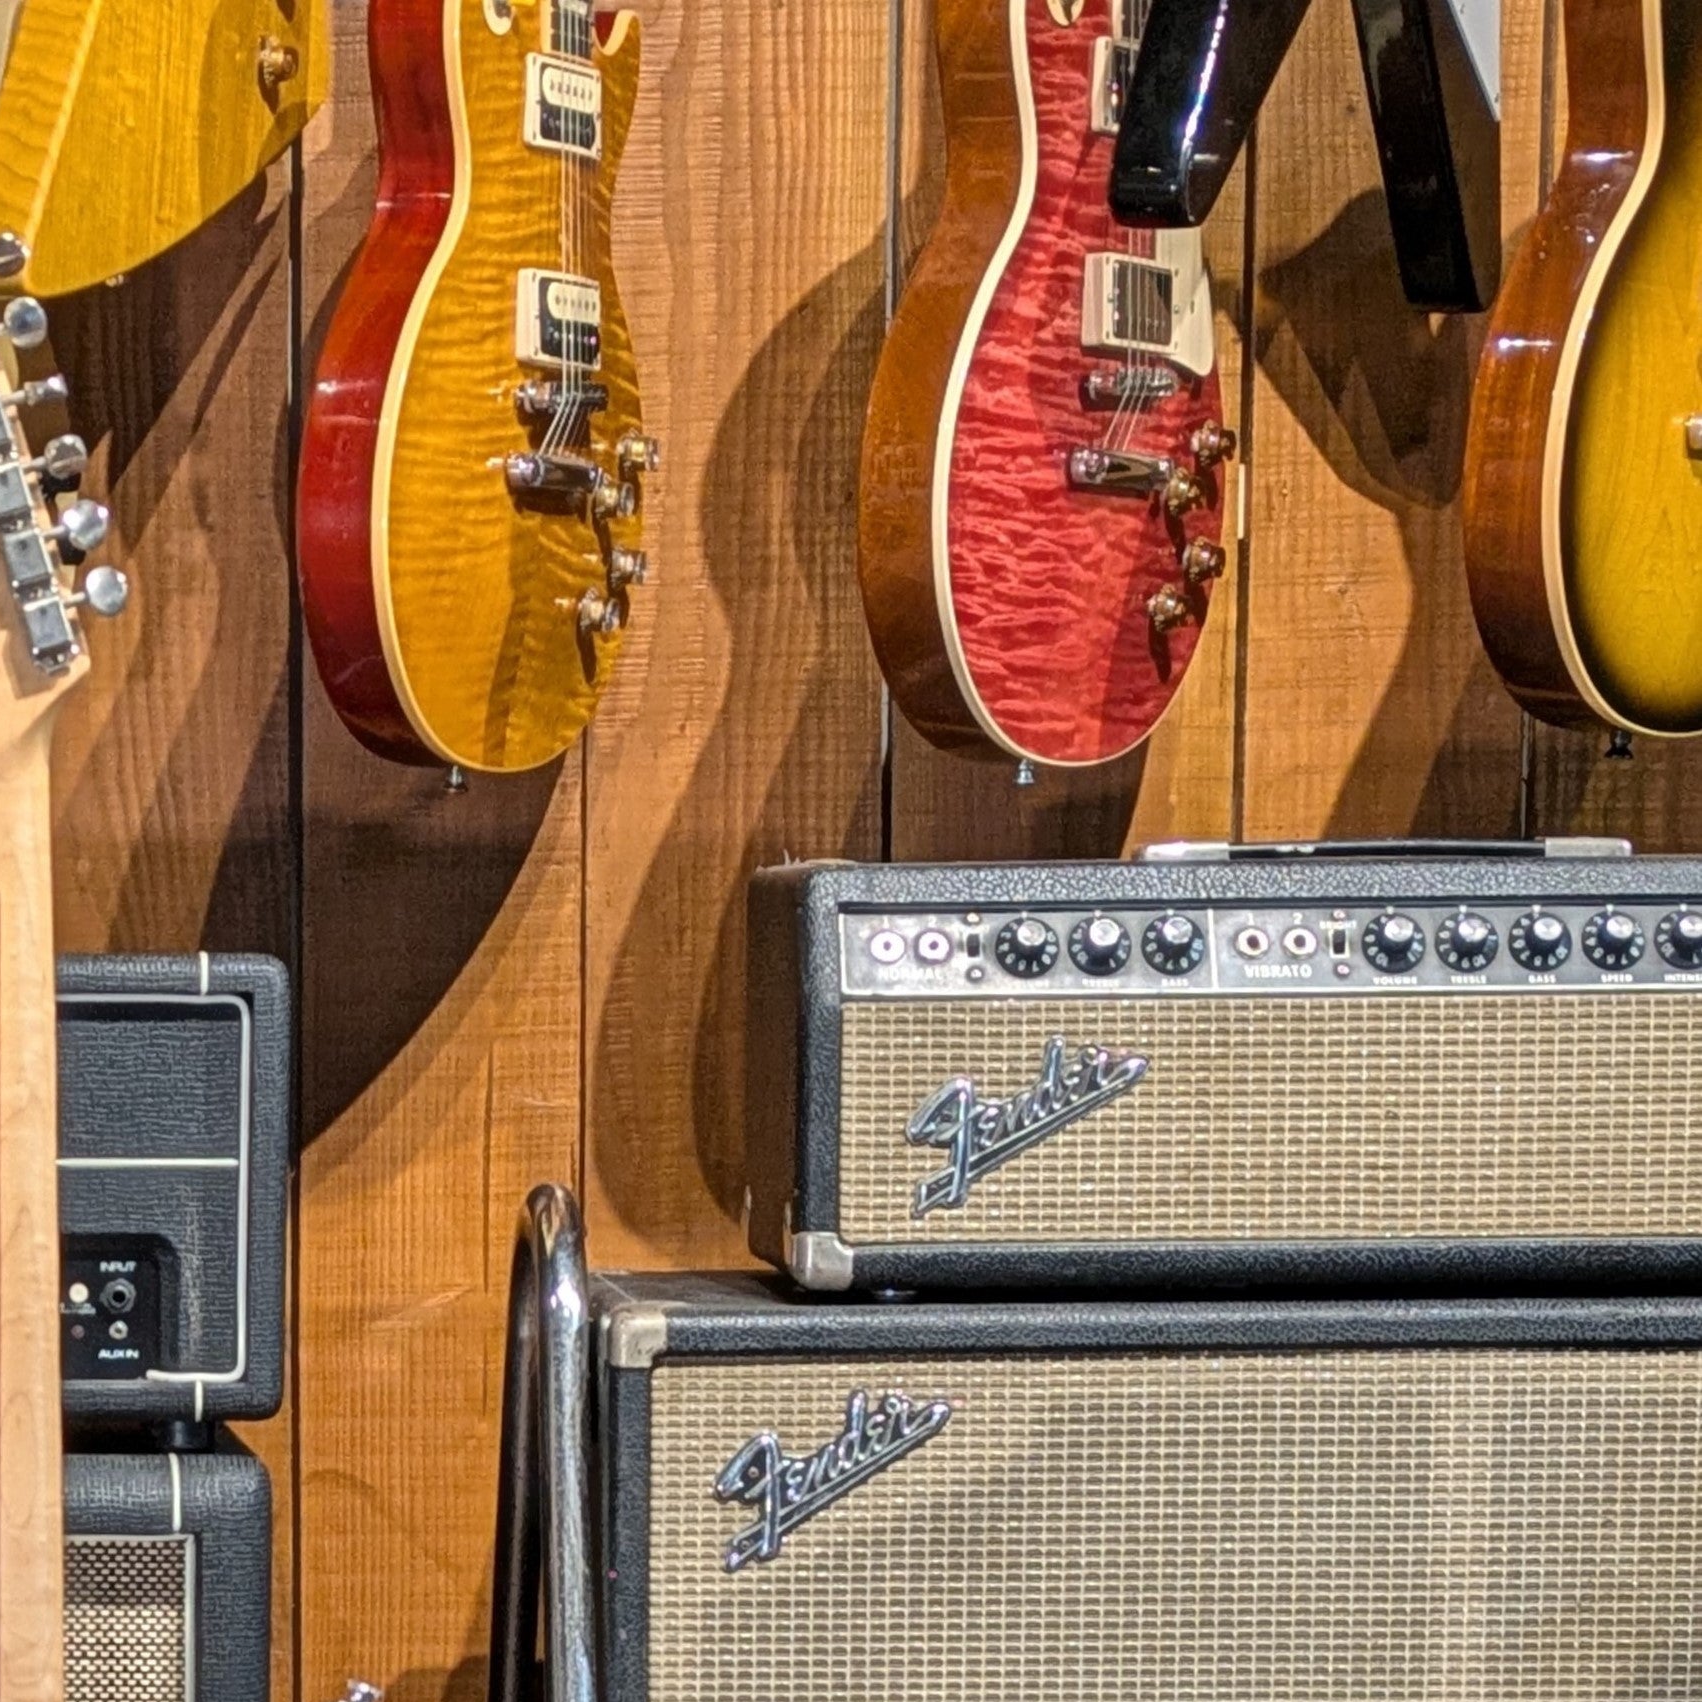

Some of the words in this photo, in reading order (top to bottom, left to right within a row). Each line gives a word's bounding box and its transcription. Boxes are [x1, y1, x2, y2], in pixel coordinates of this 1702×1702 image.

[1244, 964, 1312, 979] VIBRATO
[1373, 976, 1417, 985] VOLUME
[1528, 975, 1556, 984] BASS
[1601, 974, 1633, 983] SPEED
[905, 1033, 1149, 1218] Fender
[99, 1260, 137, 1273] INPUT
[713, 1386, 953, 1573] Fender
